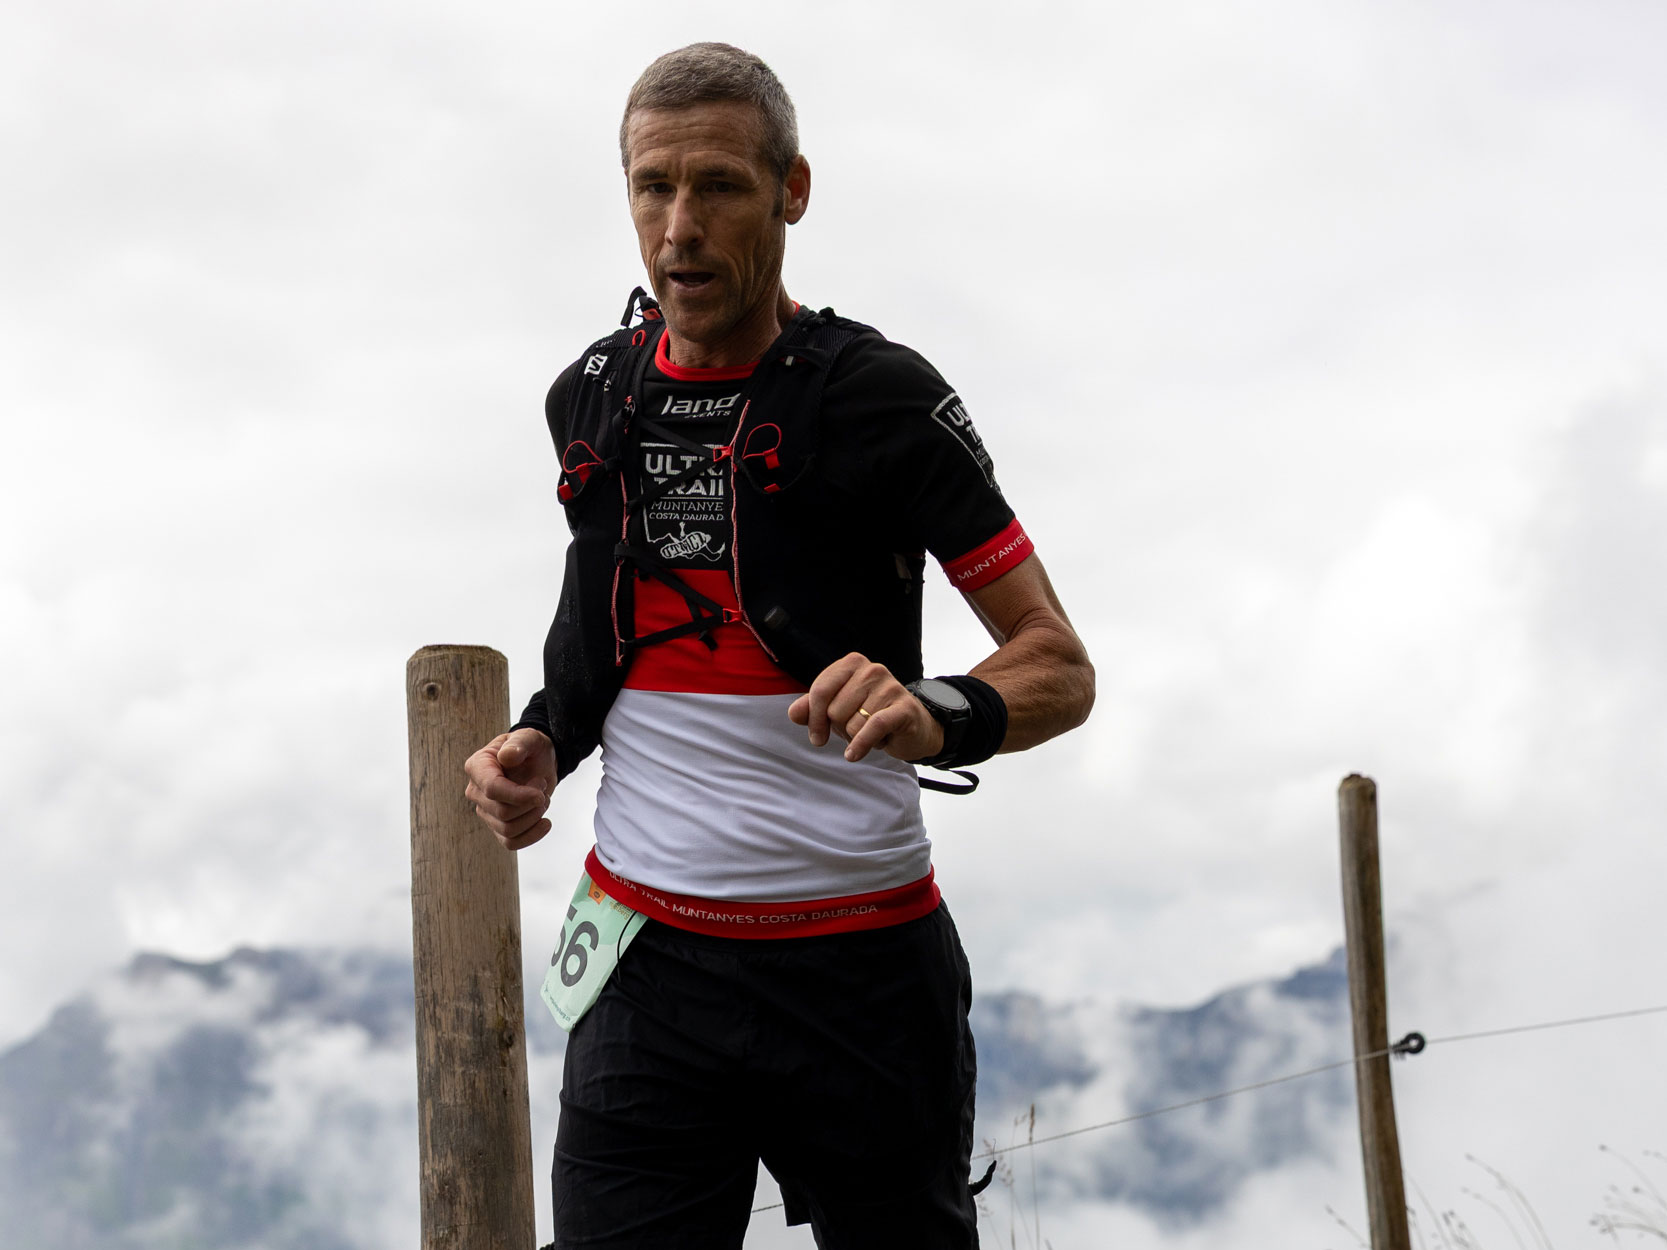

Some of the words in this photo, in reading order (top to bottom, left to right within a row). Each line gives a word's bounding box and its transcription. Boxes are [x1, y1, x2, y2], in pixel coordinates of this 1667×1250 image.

[651, 501, 724, 512] MUNTANYE
[648, 512, 680, 520] COSTA
[682, 513, 724, 521] DAURAD
[957, 533, 1027, 581] MUNTANYES
[672, 903, 756, 924] MUNTANYES
[759, 913, 807, 924] COSTA
[811, 904, 879, 921] DAURADA
